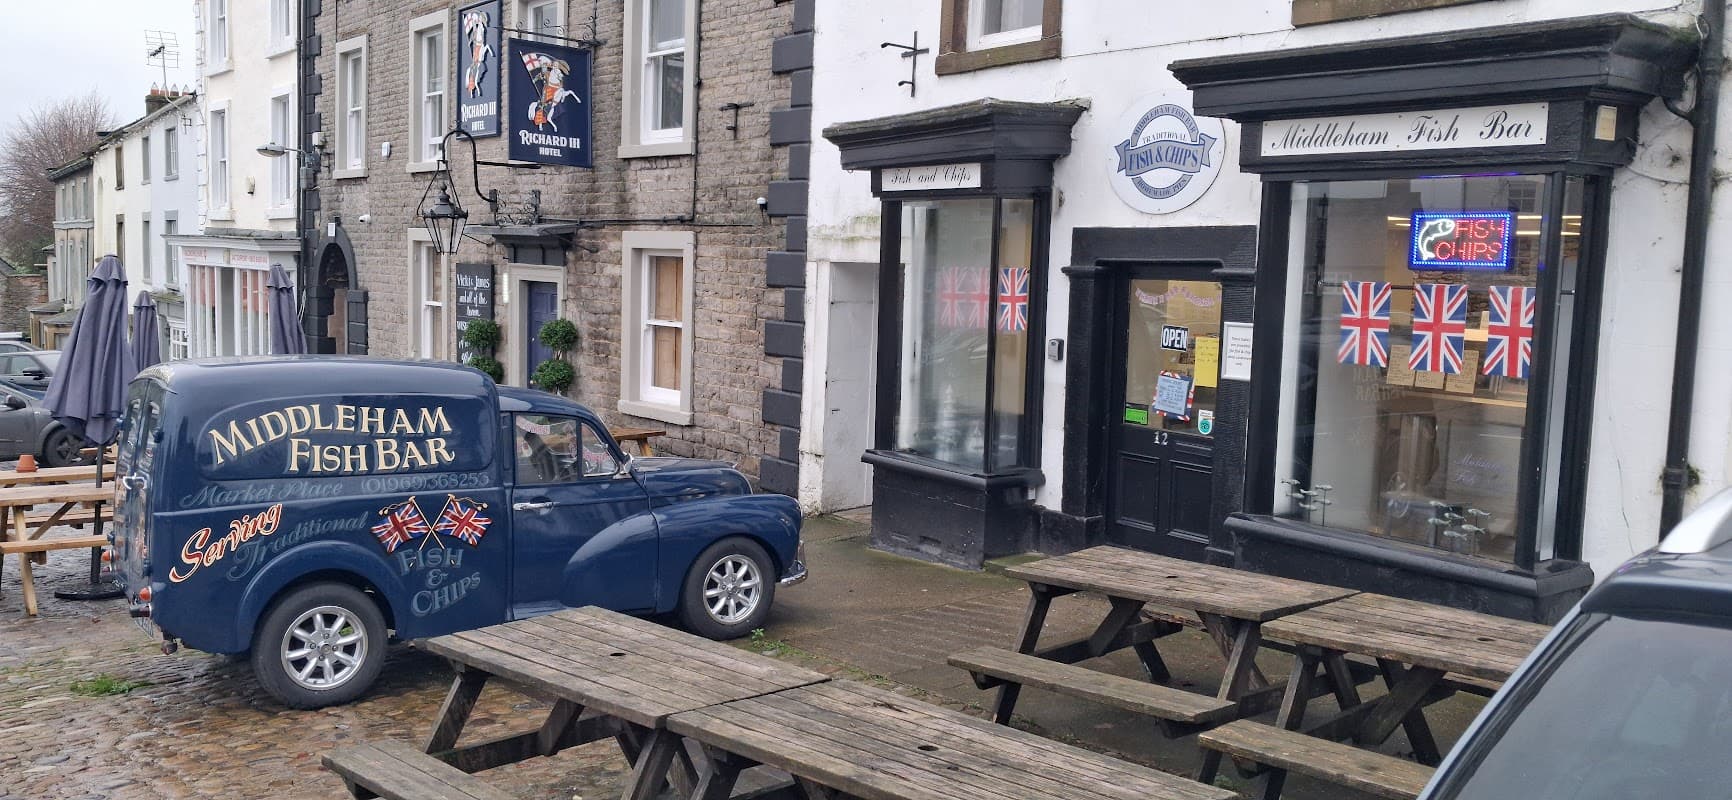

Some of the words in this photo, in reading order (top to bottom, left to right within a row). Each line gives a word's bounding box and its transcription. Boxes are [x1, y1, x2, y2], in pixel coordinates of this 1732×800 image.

[461, 103, 488, 122] RICHARD
[488, 102, 497, 116] III
[1171, 107, 1186, 119] FISH
[471, 121, 485, 131] HOTEL
[1271, 121, 1389, 149] Middleham
[1407, 114, 1460, 143] Fish
[1479, 110, 1532, 140] Bar
[518, 130, 567, 147] RICHARD
[568, 137, 580, 149] III
[1143, 132, 1186, 143] TRADITIONAL
[539, 147, 562, 157] HOTEL
[1129, 149, 1153, 171] FISH
[1155, 146, 1163, 163] &
[1165, 146, 1198, 168] CHIPS
[891, 168, 911, 184] Fish
[918, 167, 937, 184] and
[942, 166, 971, 186] Chips
[1455, 219, 1505, 239] FISH
[1435, 241, 1503, 261] CHIPS
[1162, 328, 1188, 349] OPEN
[208, 403, 453, 465] MIDDLEHAM
[1153, 431, 1169, 446] 12
[288, 437, 369, 473] FISH
[376, 437, 455, 472] BAR
[179, 480, 275, 507] Market
[279, 479, 344, 500] Place
[168, 503, 283, 583] Serving
[226, 511, 369, 581] Traditional
[398, 547, 464, 577] FISH
[425, 567, 448, 588] &
[411, 571, 481, 618] CHIPS
